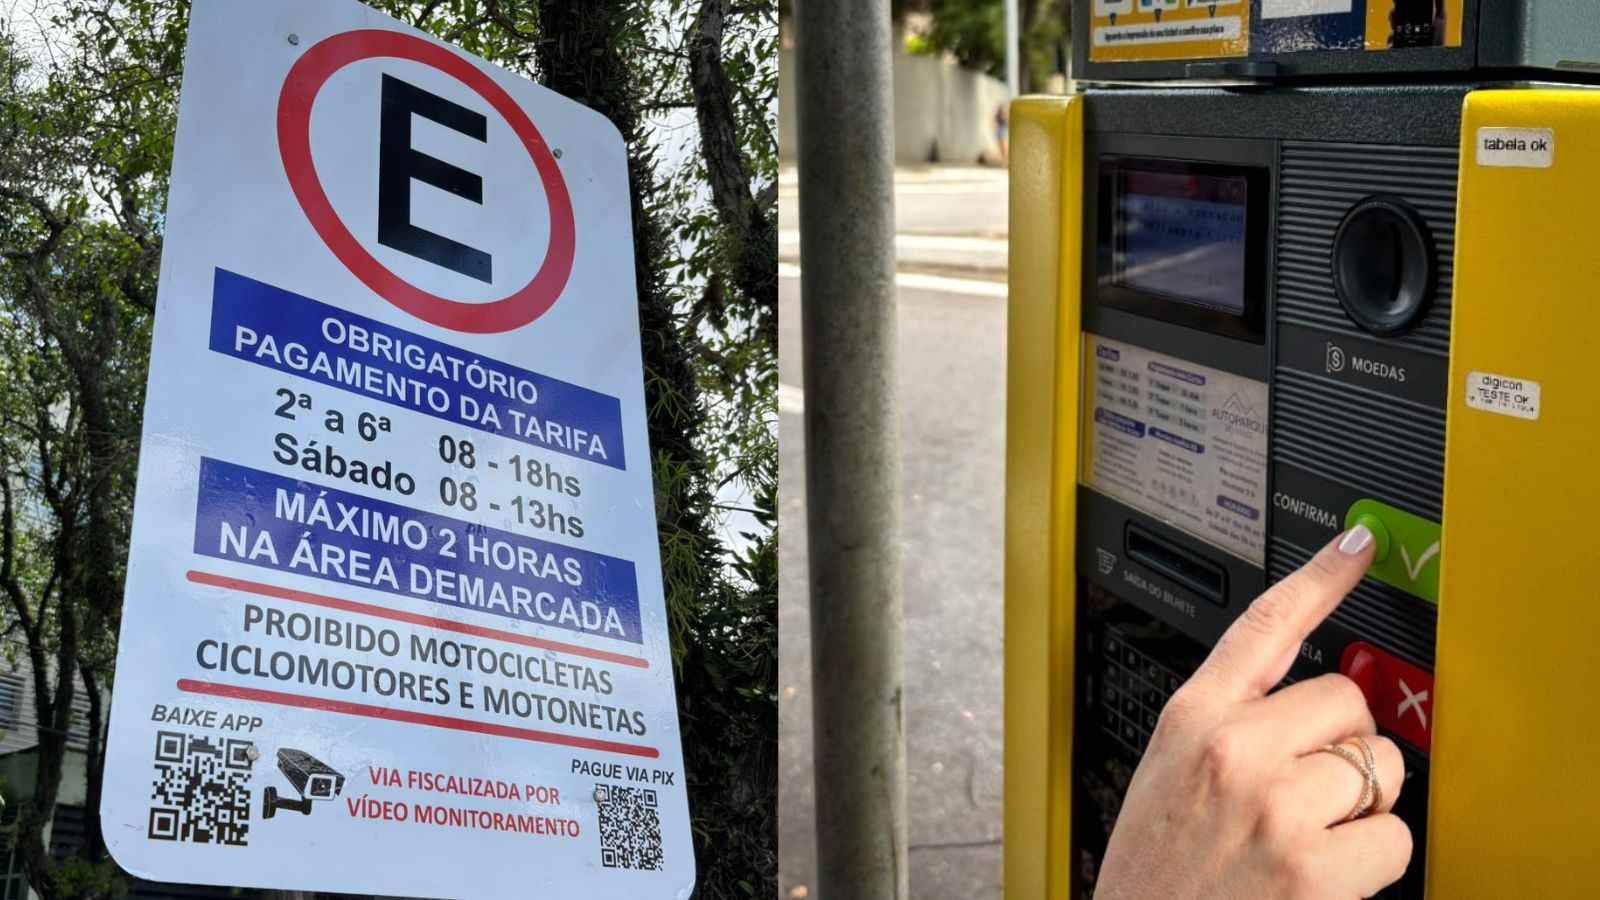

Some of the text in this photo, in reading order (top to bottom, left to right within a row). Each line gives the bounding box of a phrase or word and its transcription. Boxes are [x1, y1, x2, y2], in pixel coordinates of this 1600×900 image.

[1483, 137, 1547, 151] tabela ok
[378, 72, 492, 284] E
[234, 325, 608, 460] PAGAMENTO DA TARIFA
[321, 317, 538, 404] OBRIGATÓRIO
[1351, 356, 1406, 382] MOEDAS
[1481, 375, 1523, 391] digicon
[1477, 386, 1511, 403] TESTE
[1513, 393, 1531, 405] OK
[274, 388, 581, 498] 2ª a 6ª 08 - 18hs
[273, 432, 584, 538] Sábado 08 - 13hs
[1272, 492, 1338, 530] CONFIRMA
[275, 487, 583, 587] MÁXIMO 2 HORAS
[220, 521, 626, 637] NA ÁREA DEMARCADA
[243, 603, 614, 695] PROIBIDO MOTOCICLETAS
[151, 703, 263, 732] BAIXE APP
[196, 639, 647, 737] CICLOMOTORES E MOTONETAS
[369, 766, 560, 805] VIA FISCALIZADA POR
[571, 758, 675, 786] PAGUE VIA PIX
[347, 793, 580, 838] VÍDEO MONITORAMENTO
